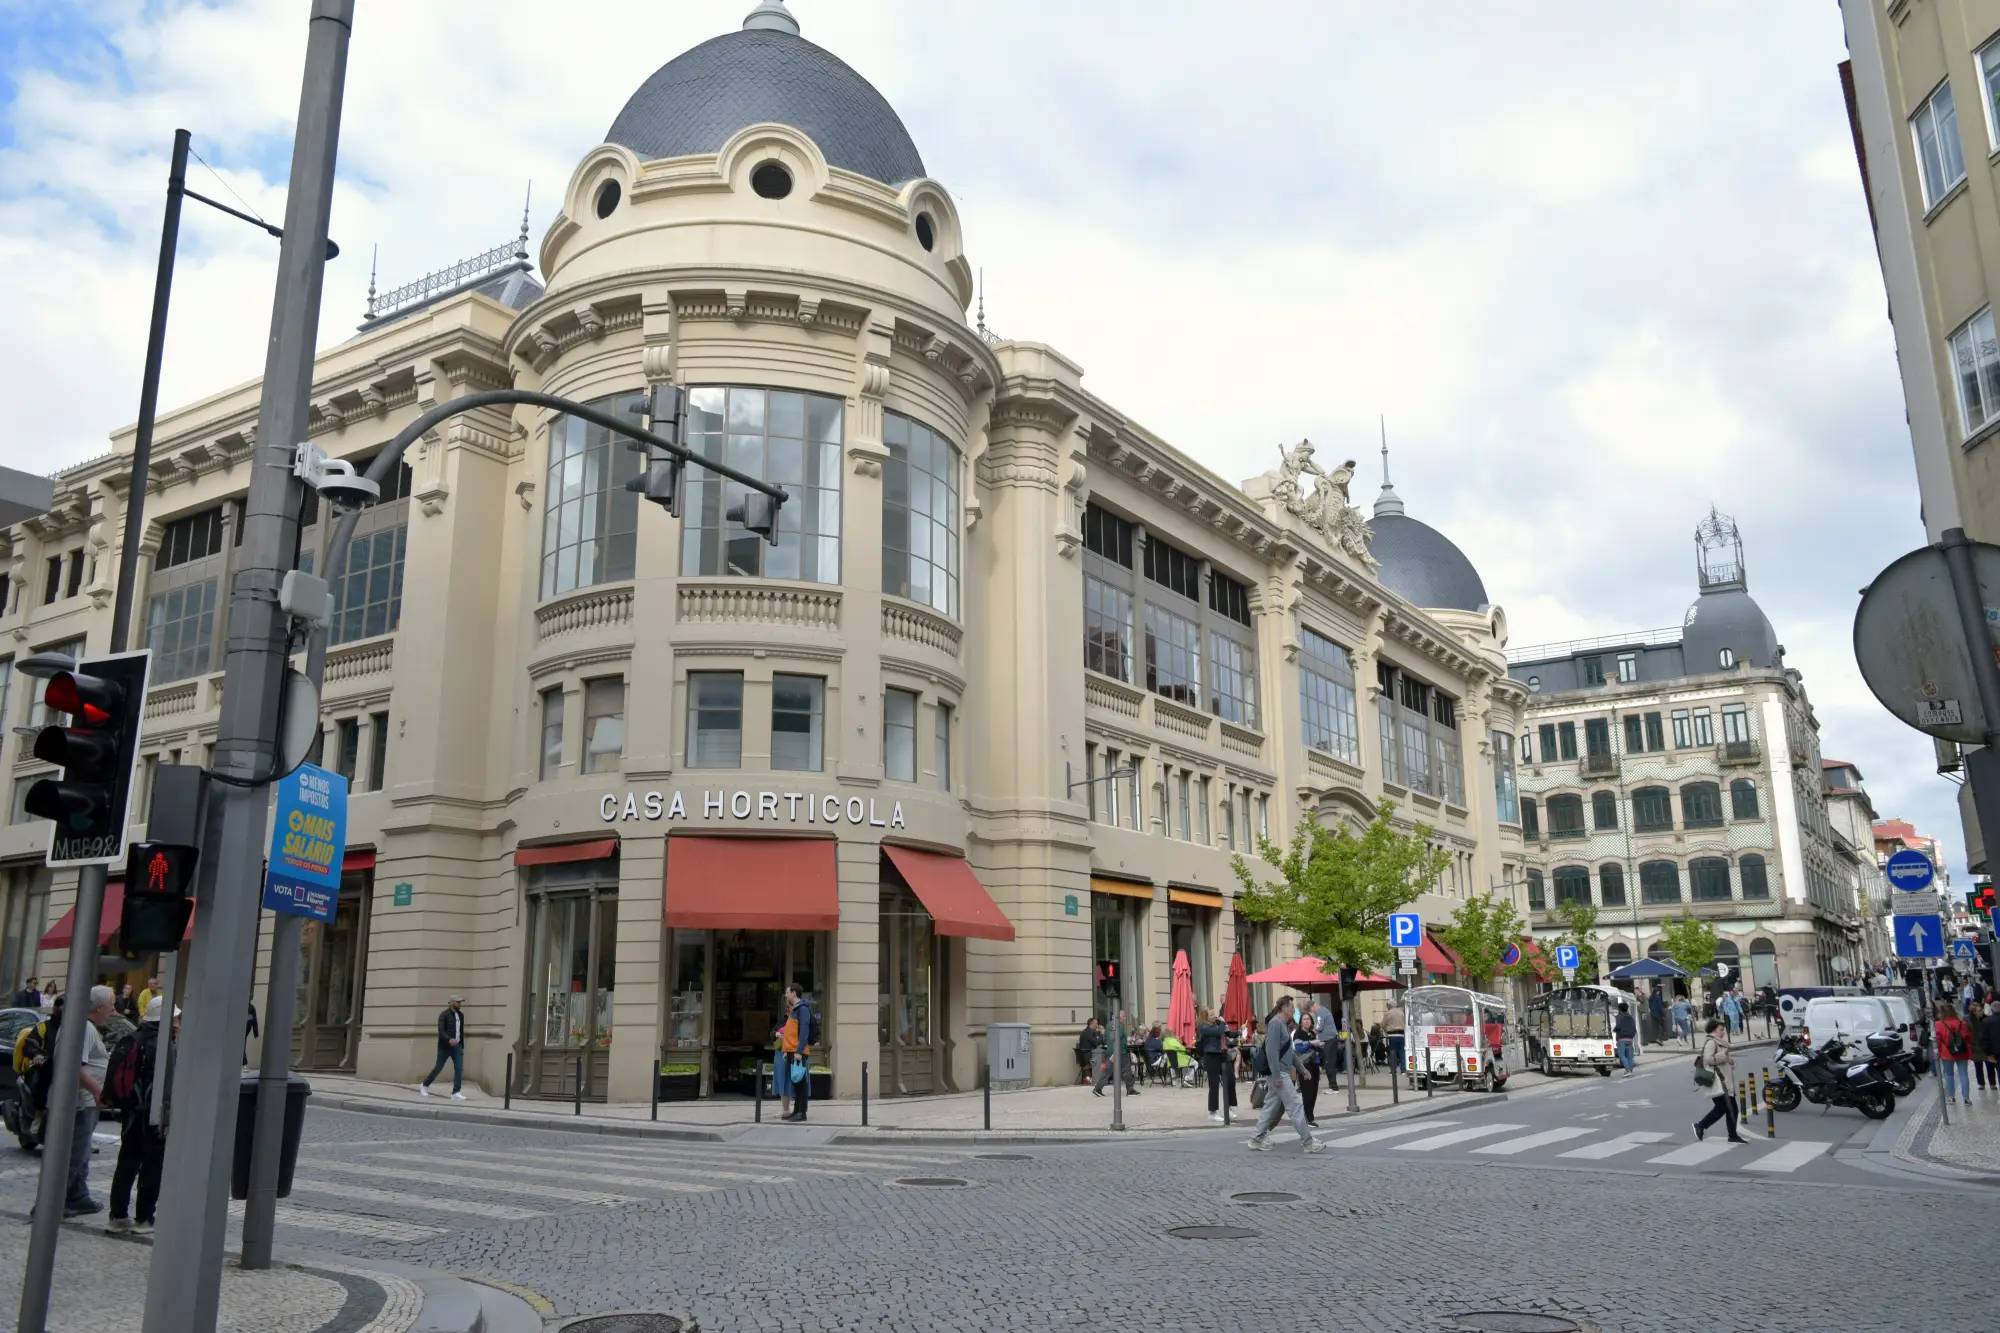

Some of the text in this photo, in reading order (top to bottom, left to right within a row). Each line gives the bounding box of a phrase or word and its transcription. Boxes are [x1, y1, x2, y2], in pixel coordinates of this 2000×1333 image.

[299, 787, 329, 810] IMPOSTOS
[600, 790, 905, 829] CASA HORTICOLA
[303, 814, 336, 842] MAIS
[283, 832, 335, 865] SALÁRIO
[274, 884, 293, 897] VOTA
[1396, 916, 1414, 945] P
[1561, 948, 1574, 967] P
